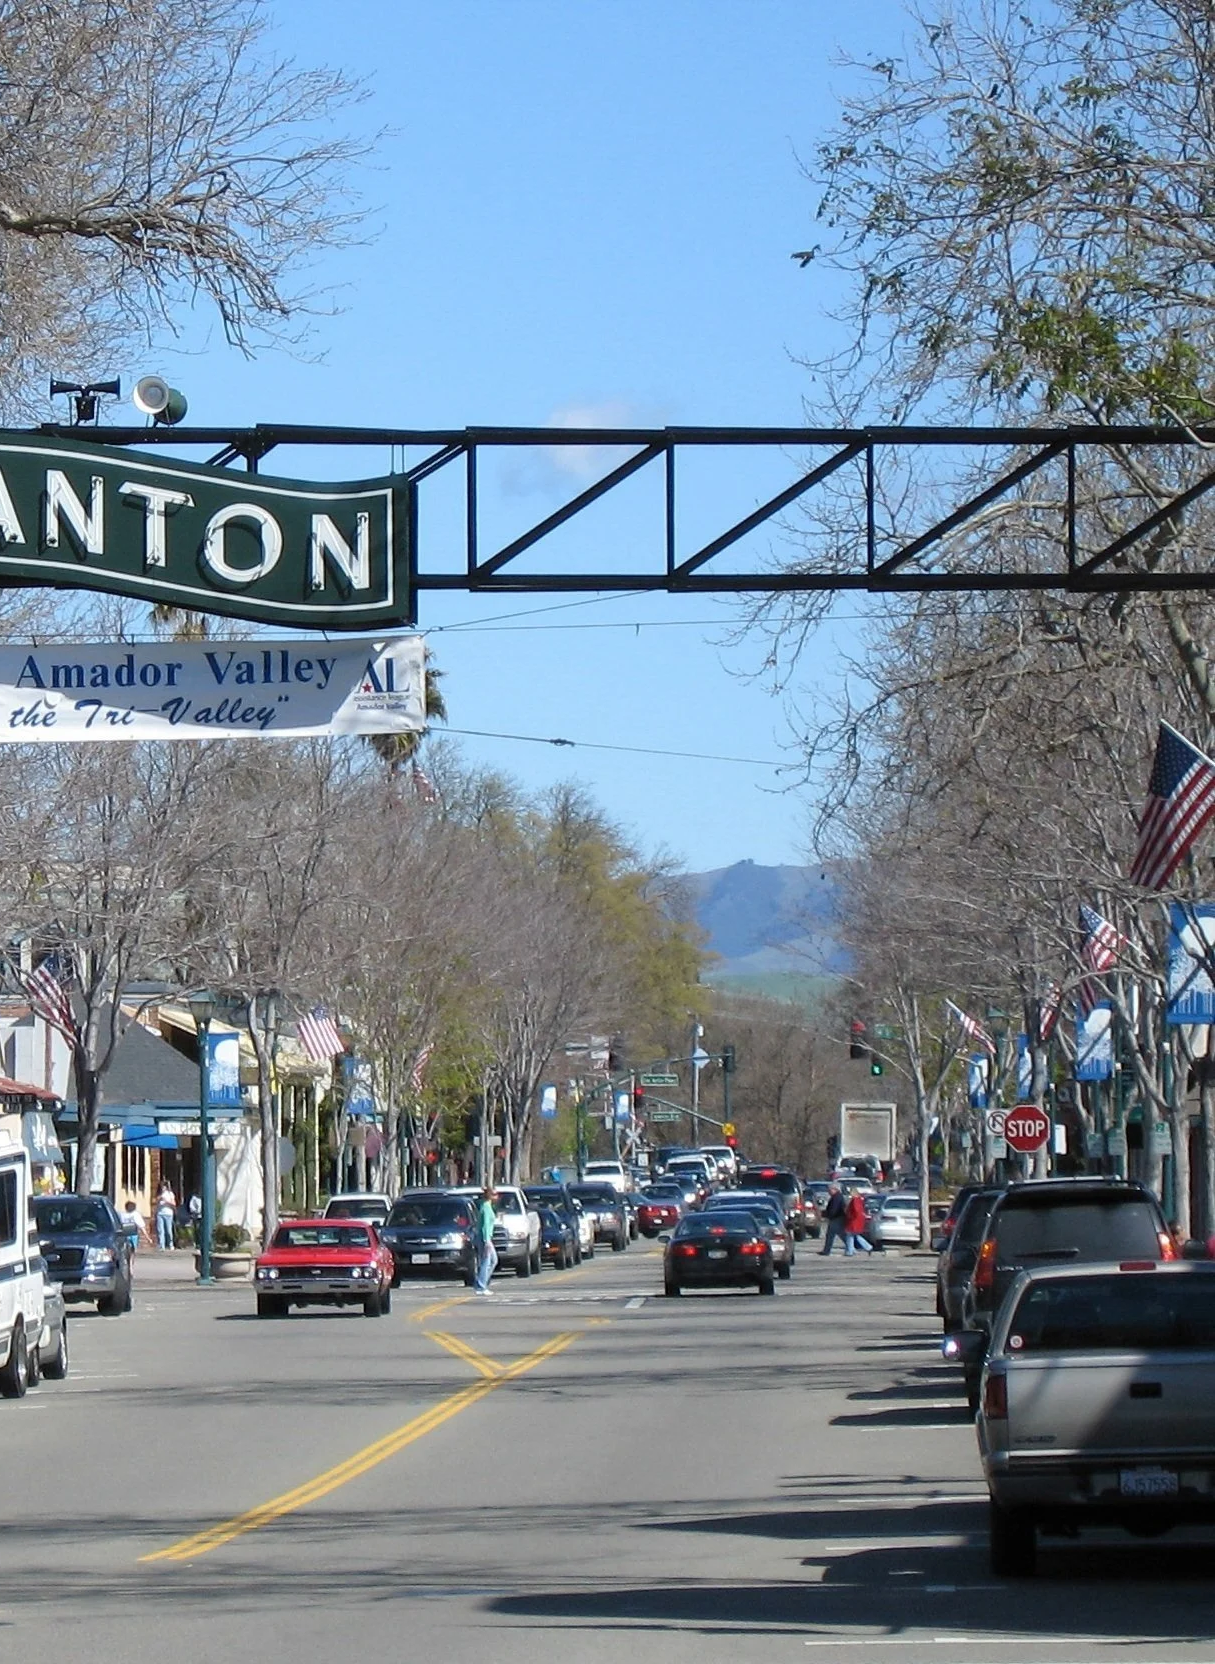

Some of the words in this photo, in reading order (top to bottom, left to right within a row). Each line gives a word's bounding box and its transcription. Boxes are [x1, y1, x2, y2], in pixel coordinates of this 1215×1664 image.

[15, 654, 183, 688] Amador
[204, 650, 337, 689] Valley
[354, 657, 410, 694] AL
[8, 698, 58, 729] the
[1007, 1119, 1046, 1139] STOP
